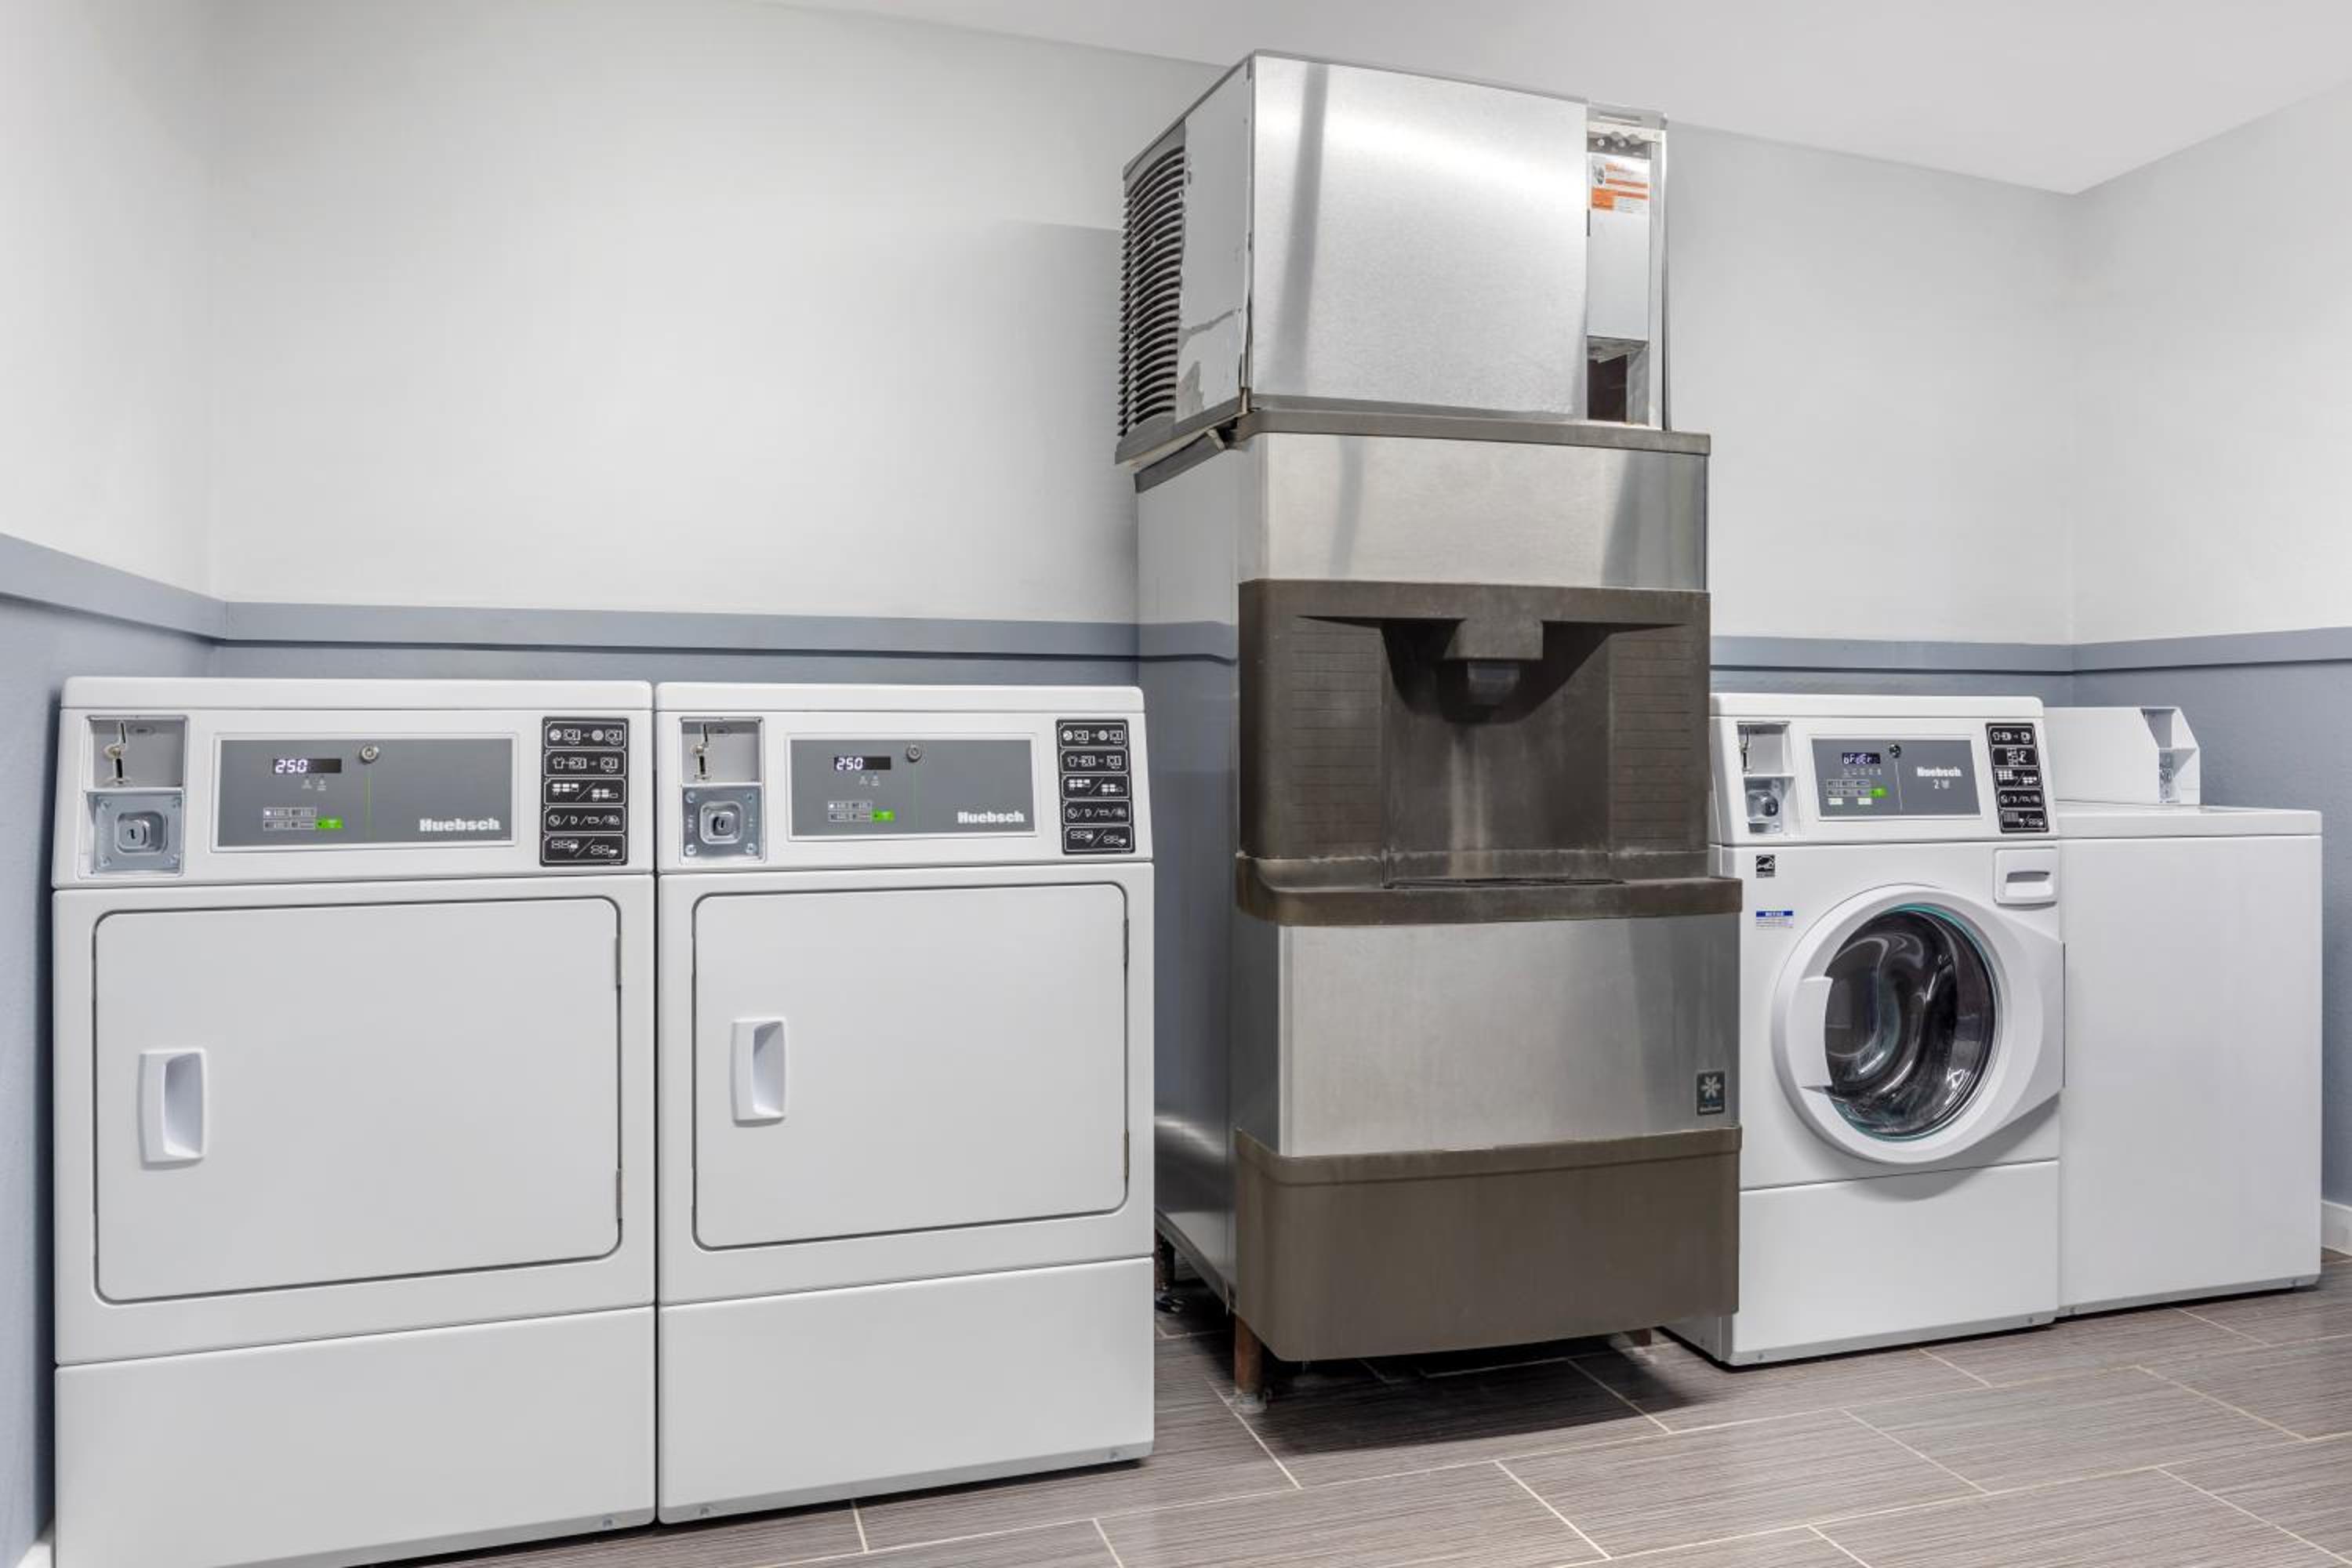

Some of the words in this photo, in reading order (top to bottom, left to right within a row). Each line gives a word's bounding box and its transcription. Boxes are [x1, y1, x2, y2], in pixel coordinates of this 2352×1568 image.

[275, 759, 308, 774] 250
[837, 757, 863, 770] 250
[957, 811, 1025, 824] Huebsch
[419, 818, 502, 832] Huebsch
